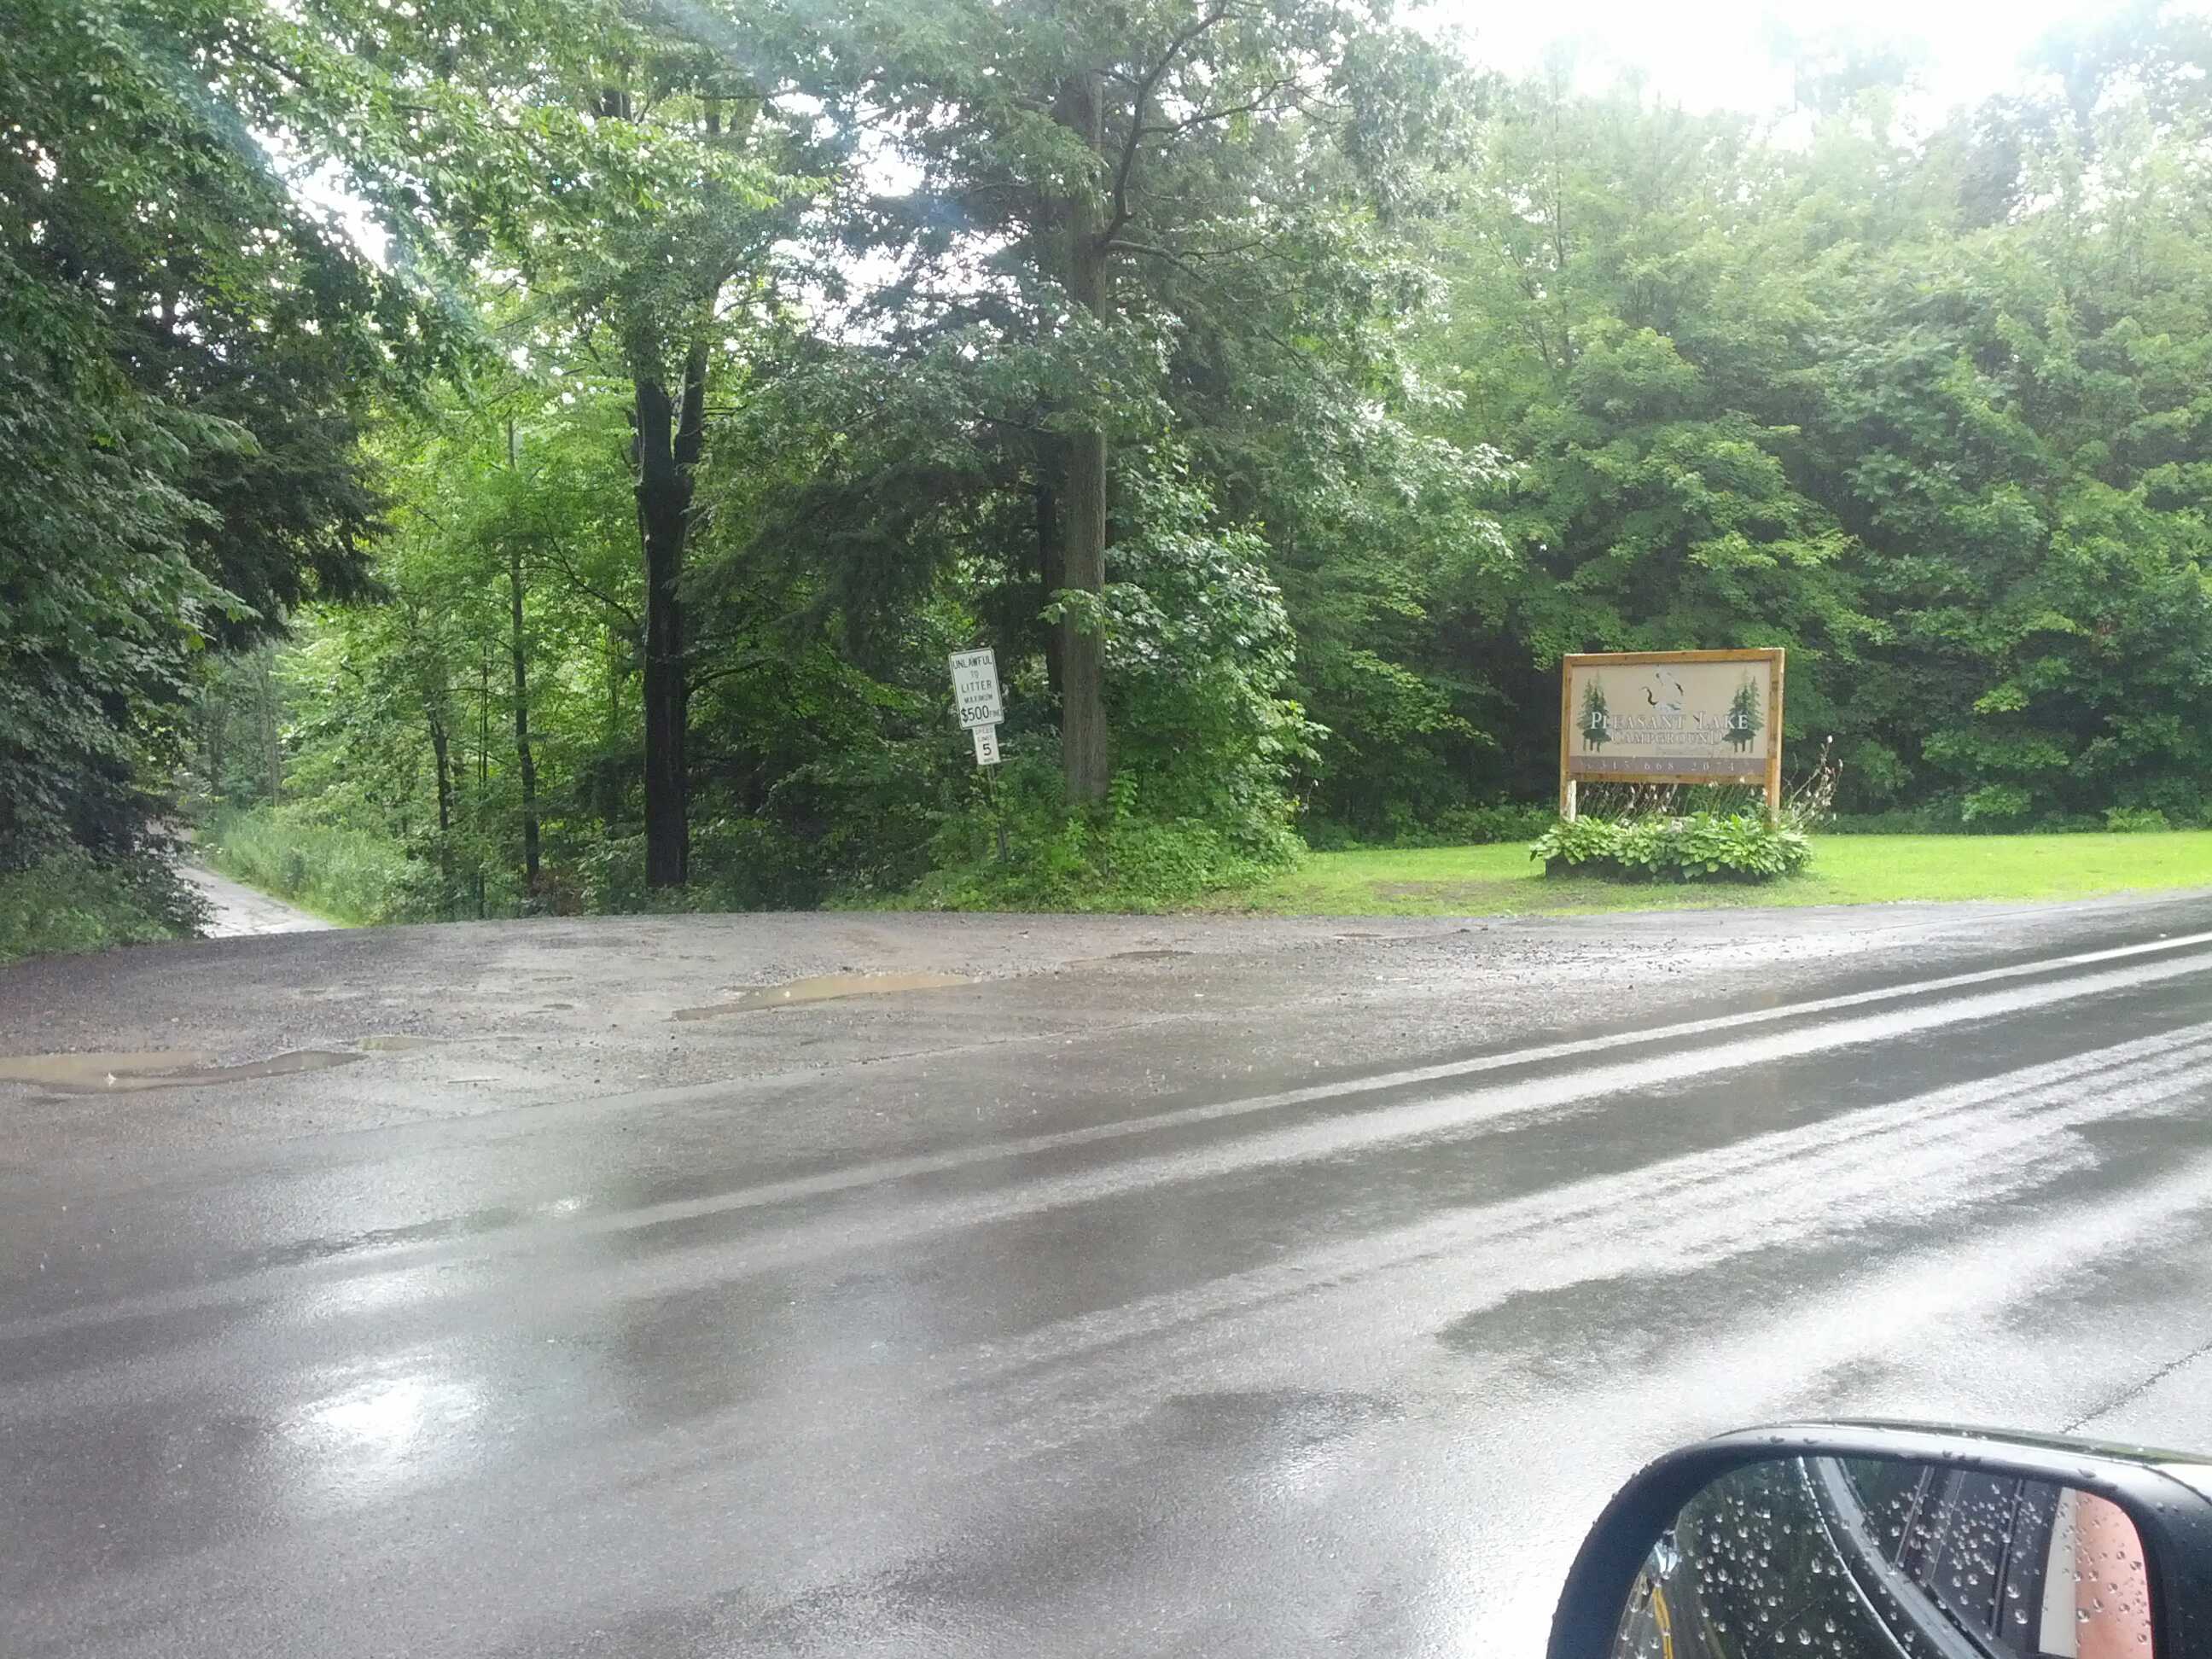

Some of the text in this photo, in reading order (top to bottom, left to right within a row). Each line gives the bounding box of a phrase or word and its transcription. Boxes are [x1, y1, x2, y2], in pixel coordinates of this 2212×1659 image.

[952, 655, 992, 670] UNLAWFUL
[970, 670, 980, 678] TO
[961, 679, 992, 693] LITTER
[963, 694, 993, 703] MAXIMUM
[960, 705, 989, 723] $500
[1591, 710, 1749, 731] PLEASANT LAKE
[1610, 730, 1723, 746] CAMPGROUND
[982, 742, 992, 756] 5
[1644, 760, 1674, 770] 668
